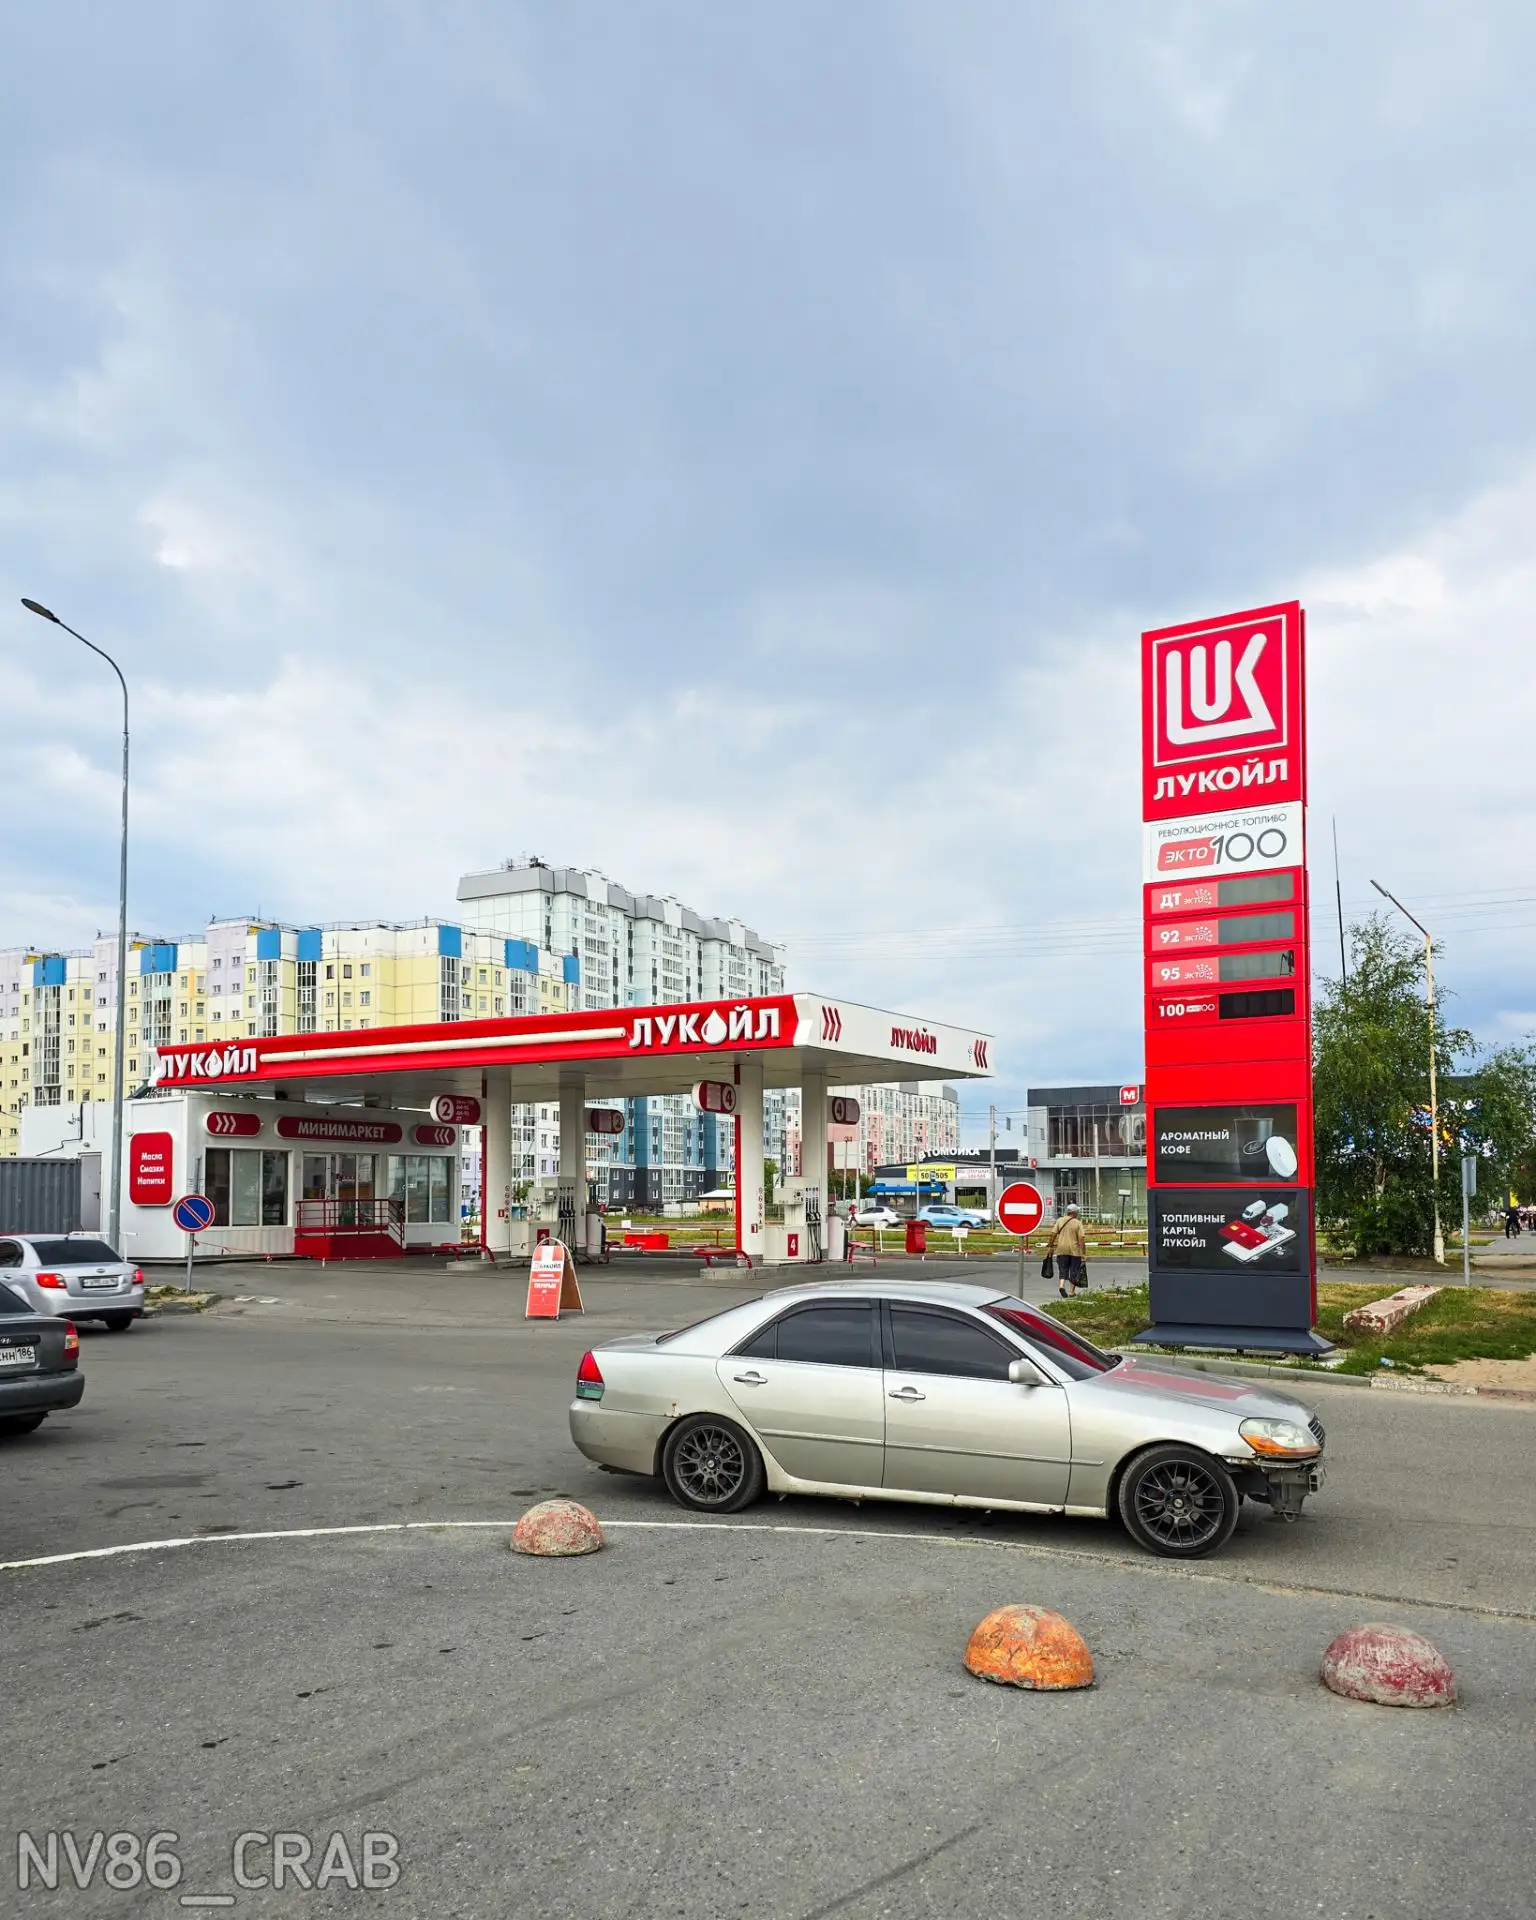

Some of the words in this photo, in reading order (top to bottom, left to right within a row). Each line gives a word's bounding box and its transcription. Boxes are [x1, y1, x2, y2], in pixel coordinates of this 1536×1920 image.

[1153, 758, 1288, 801] ЛУКОЙЛ
[1158, 819, 1240, 838] РЕВОЛЮЦИОННОЕ
[1242, 813, 1288, 827] ТОПЛИВО
[1164, 847, 1208, 864] ЭКТО
[1212, 828, 1287, 864] 100
[1160, 892, 1182, 909] ДТ
[1184, 896, 1204, 904] ЭКТО
[1160, 930, 1180, 944] 92
[1160, 968, 1181, 980] 95
[1159, 1004, 1185, 1017] 100
[629, 1005, 780, 1048] ЛУКОЙЛ
[891, 1027, 937, 1054] ЛУКОЙЛ
[723, 1090, 733, 1106] 4
[442, 1101, 451, 1116] 2
[298, 1121, 385, 1139] МИНИМАРКЕТ
[1160, 1129, 1230, 1141] АРОМАТНЫЙ
[141, 1152, 163, 1161] Масла
[1161, 1145, 1191, 1155] КОФЕ
[140, 1164, 164, 1173] Смазки
[137, 1176, 165, 1185] Напитки
[1162, 1214, 1226, 1224] ТОПЛИВНЫЕ
[1162, 1227, 1196, 1236] КАРТЫ
[790, 1239, 796, 1252] 4
[1162, 1238, 1206, 1249] ЛУКОЙЛ
[17, 1347, 32, 1357] 186
